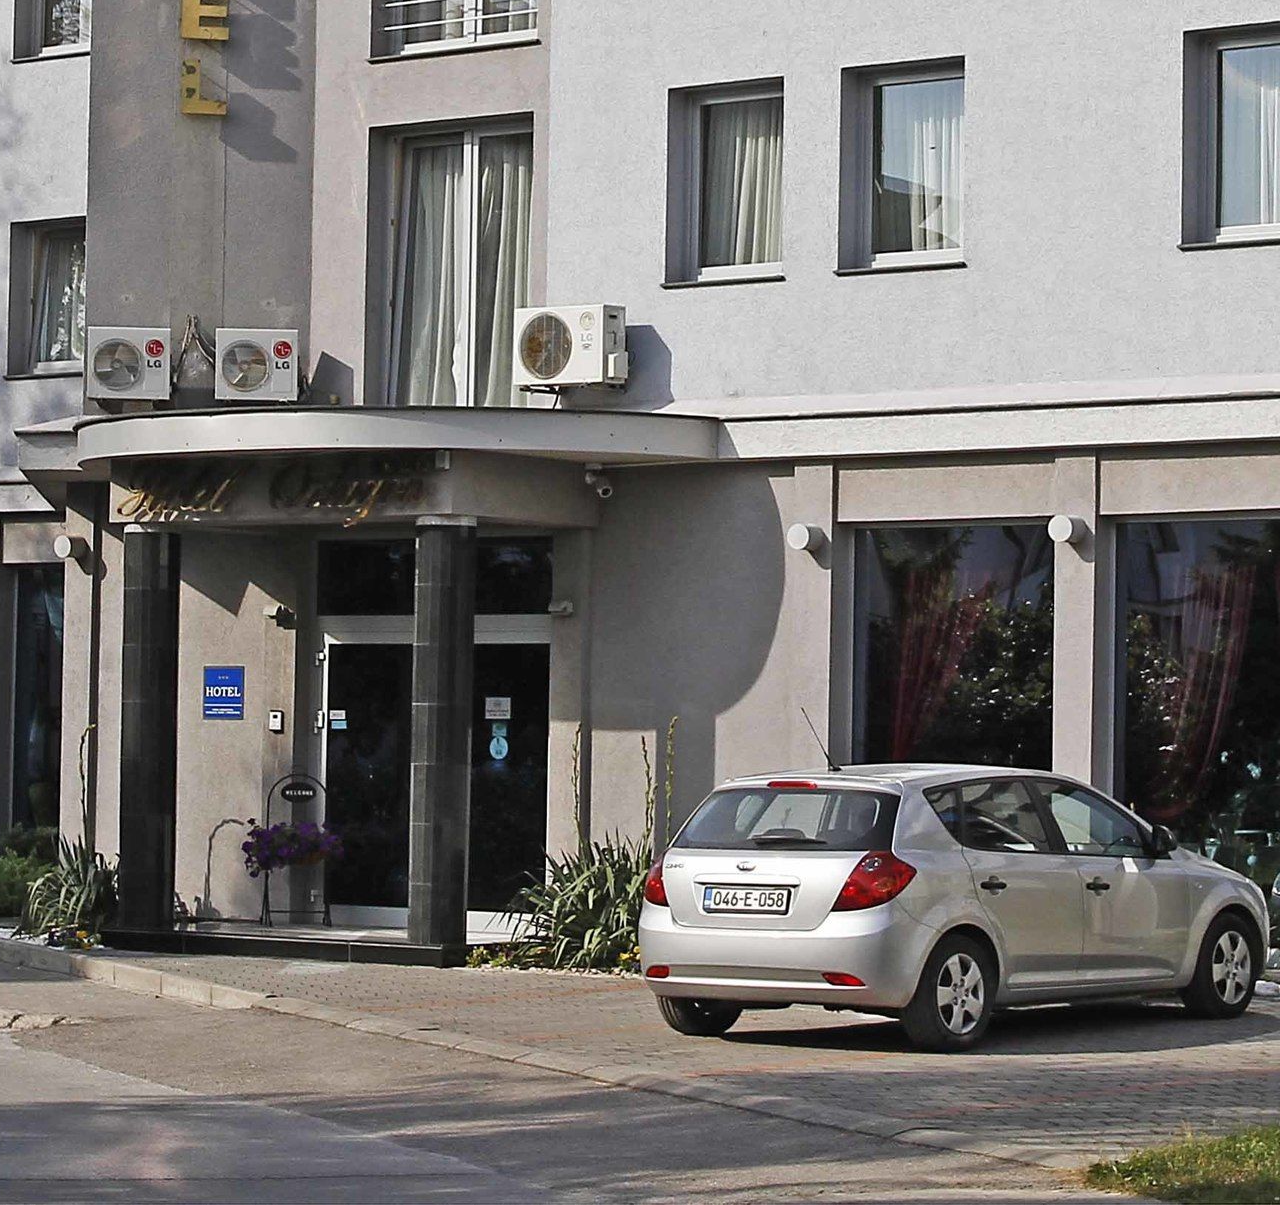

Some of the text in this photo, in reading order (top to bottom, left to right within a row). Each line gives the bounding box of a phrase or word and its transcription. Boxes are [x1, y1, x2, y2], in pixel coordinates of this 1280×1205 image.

[580, 333, 593, 342] LG
[146, 359, 162, 369] LG
[274, 360, 290, 370] LG
[205, 686, 241, 697] HOTEL
[713, 891, 784, 908] 046-E-058
